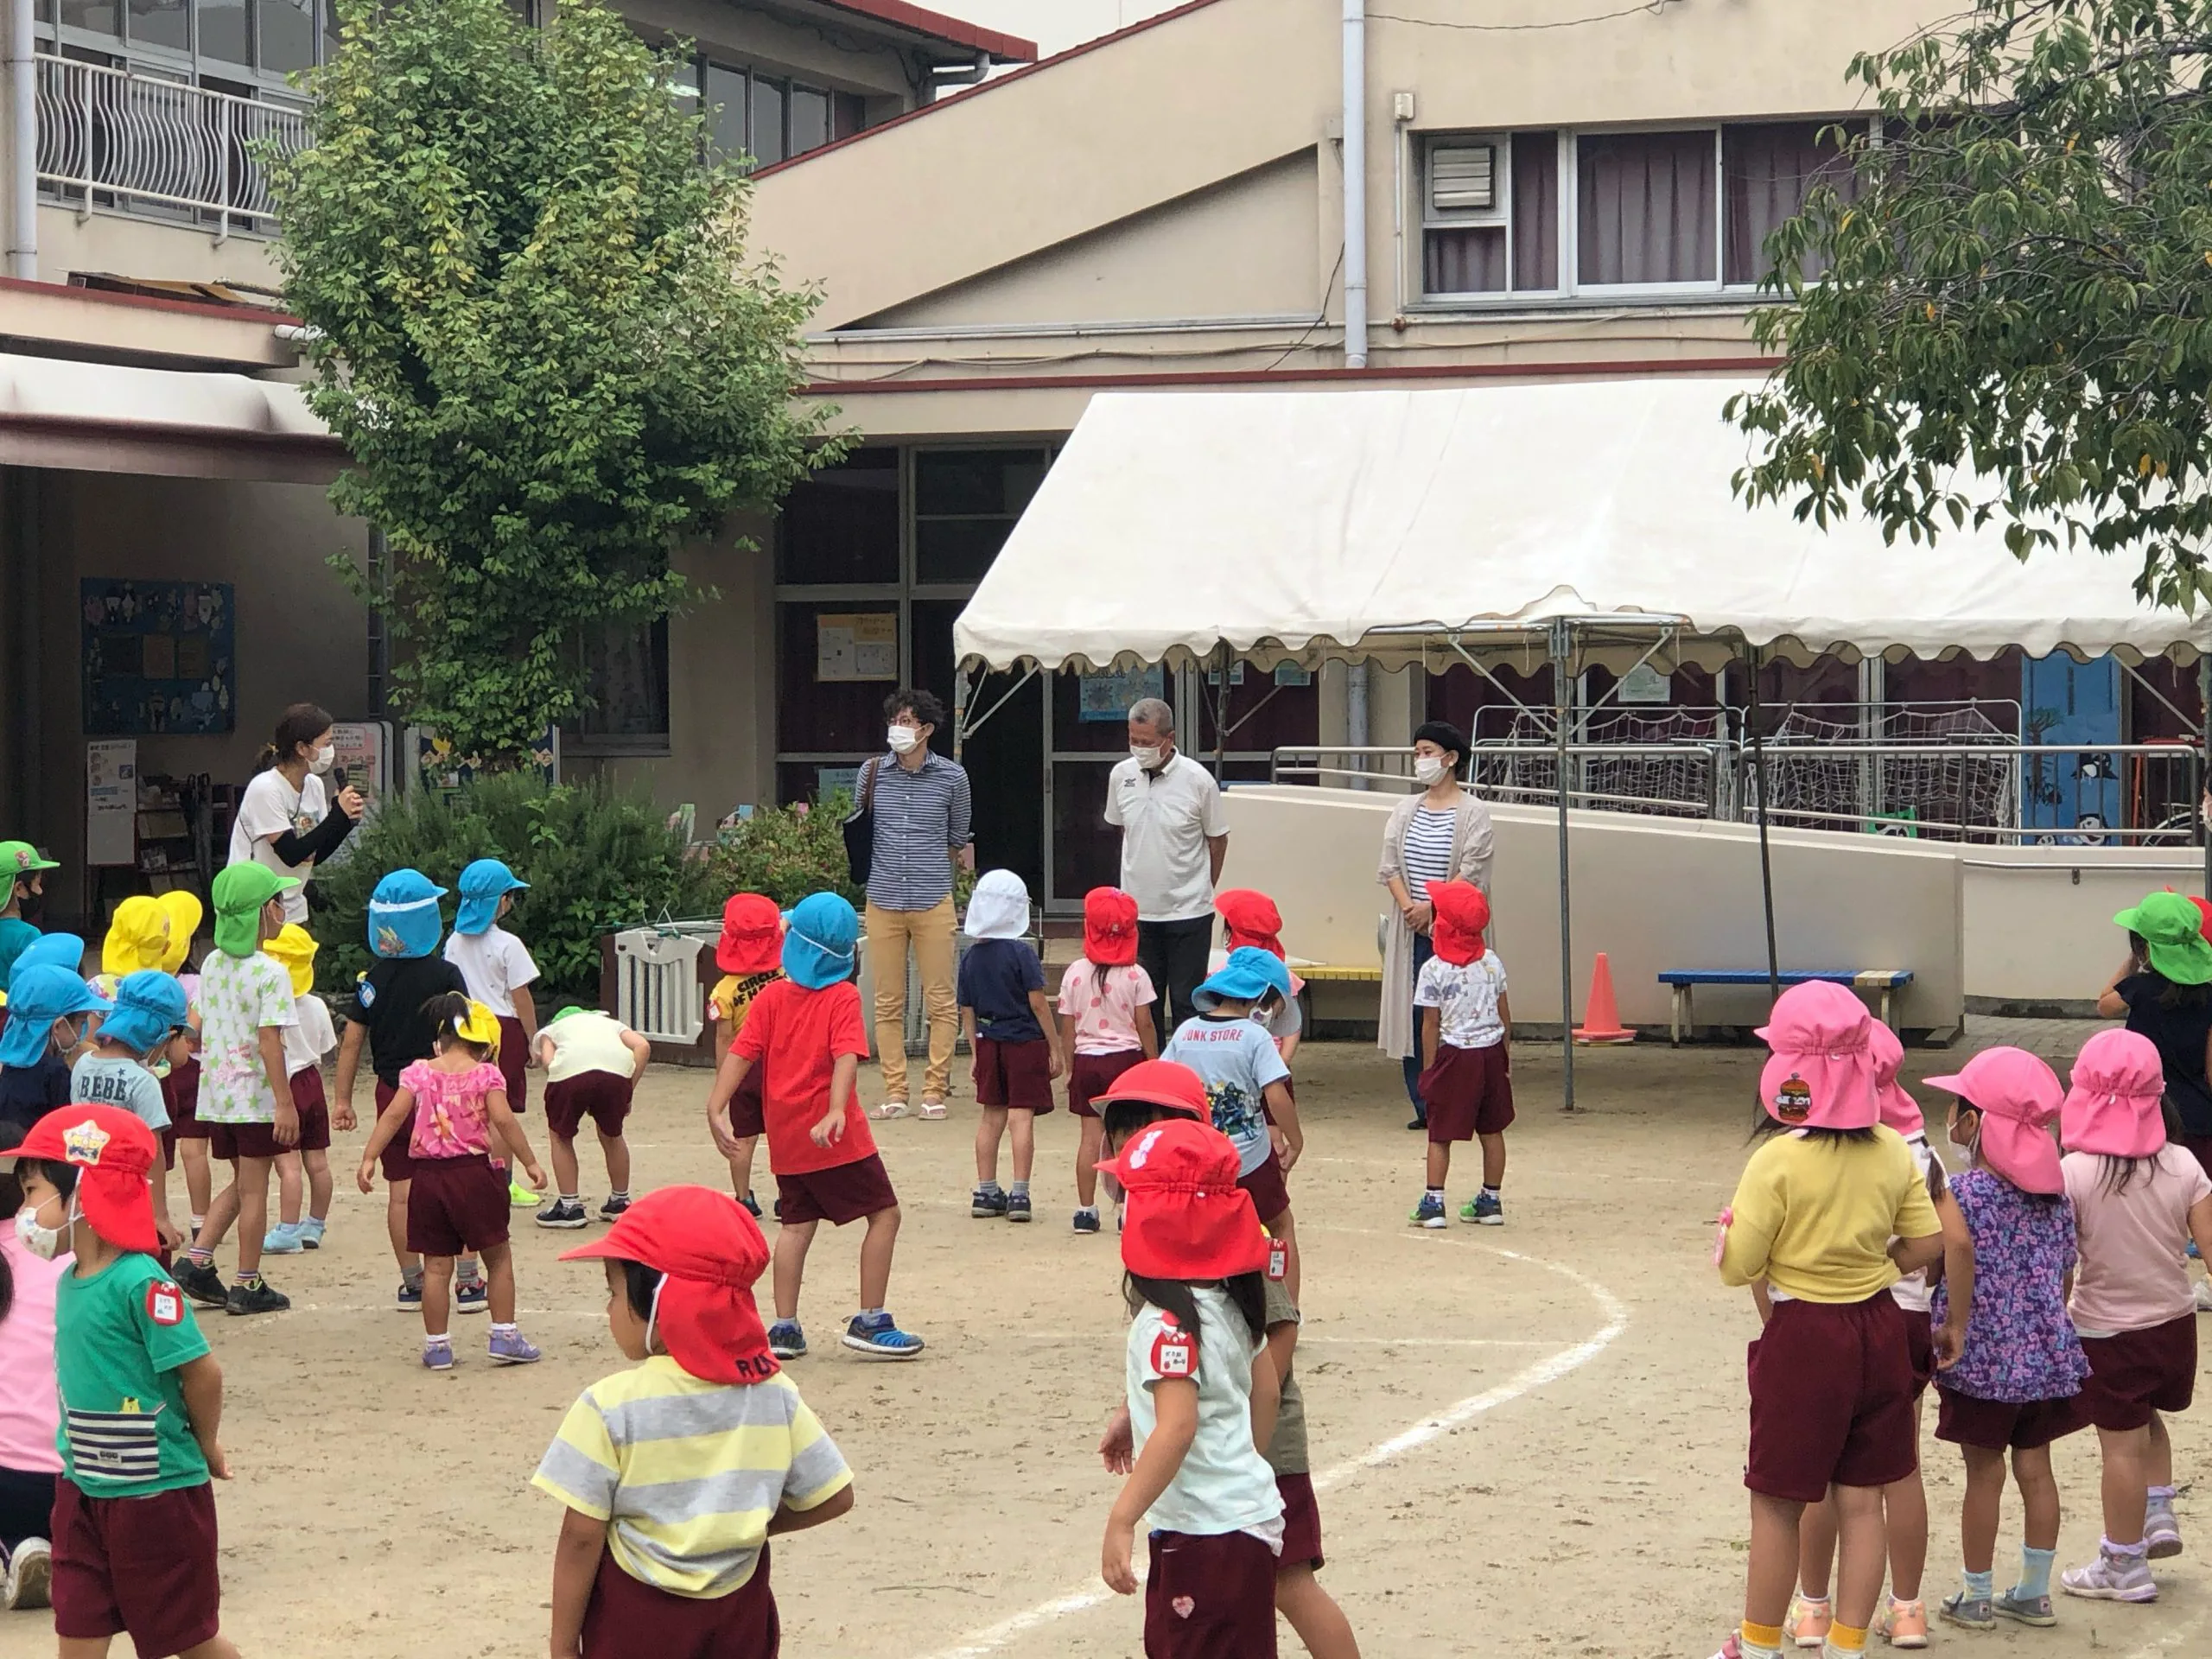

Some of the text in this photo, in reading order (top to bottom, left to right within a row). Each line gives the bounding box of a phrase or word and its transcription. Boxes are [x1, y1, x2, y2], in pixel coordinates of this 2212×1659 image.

[1182, 1028, 1244, 1041] JUNK STORE
[80, 1076, 127, 1101] BEBE
